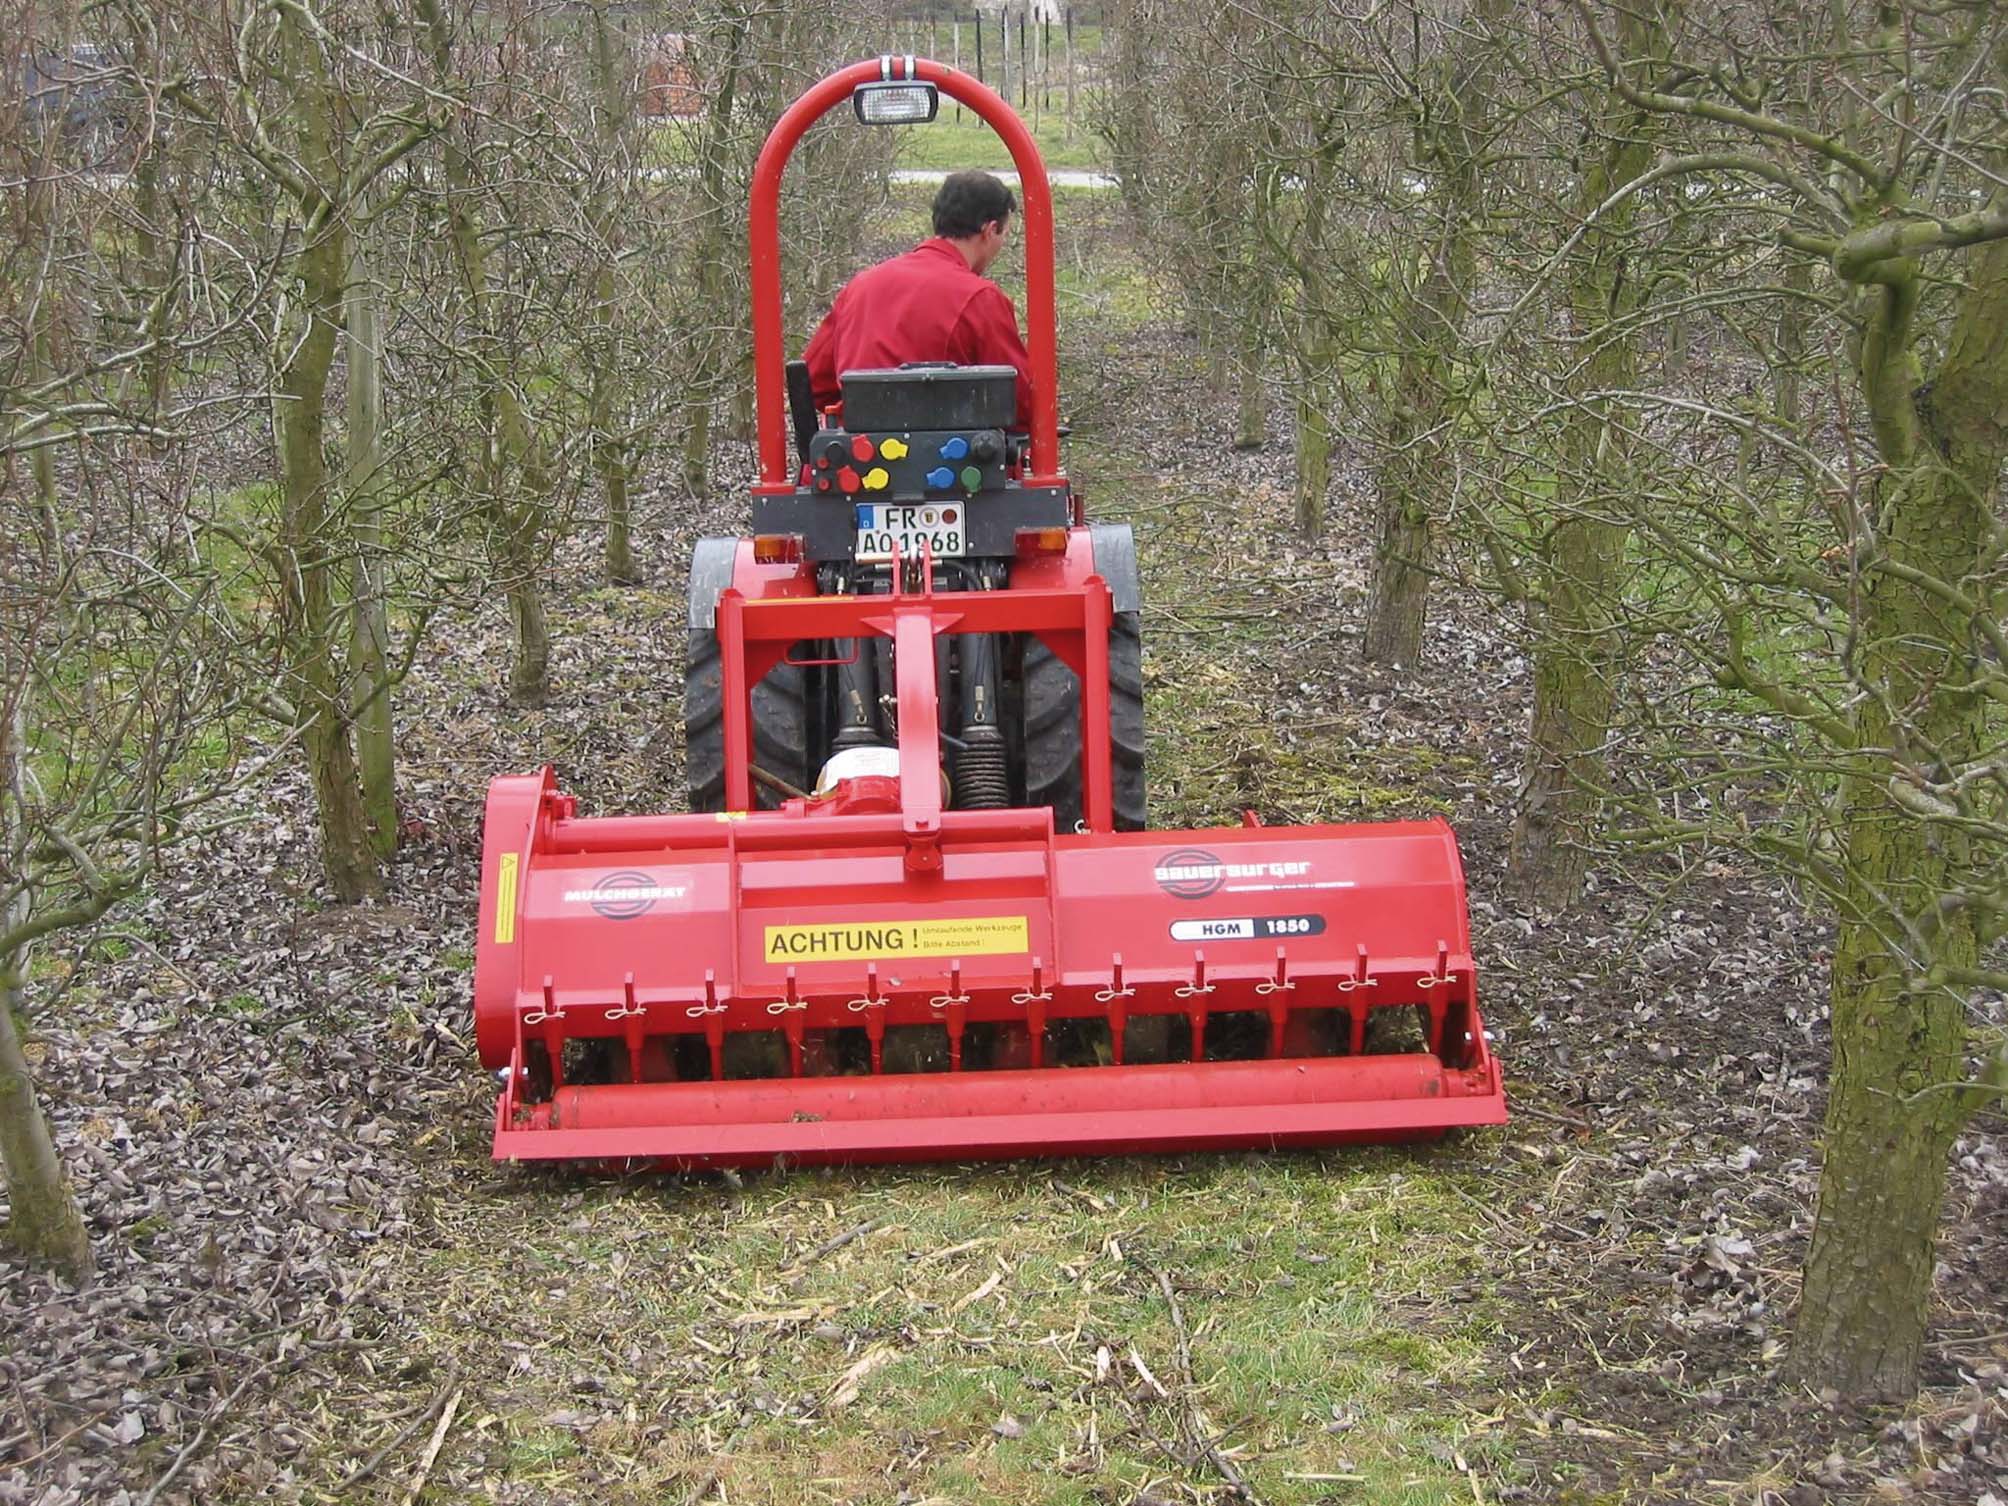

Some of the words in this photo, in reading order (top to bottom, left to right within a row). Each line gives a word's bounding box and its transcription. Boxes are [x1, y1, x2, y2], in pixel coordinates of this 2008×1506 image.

[886, 508, 917, 529] FR
[975, 924, 1022, 933] Werkzeuge
[1203, 923, 1241, 935] HGM
[1267, 919, 1310, 933] 1850
